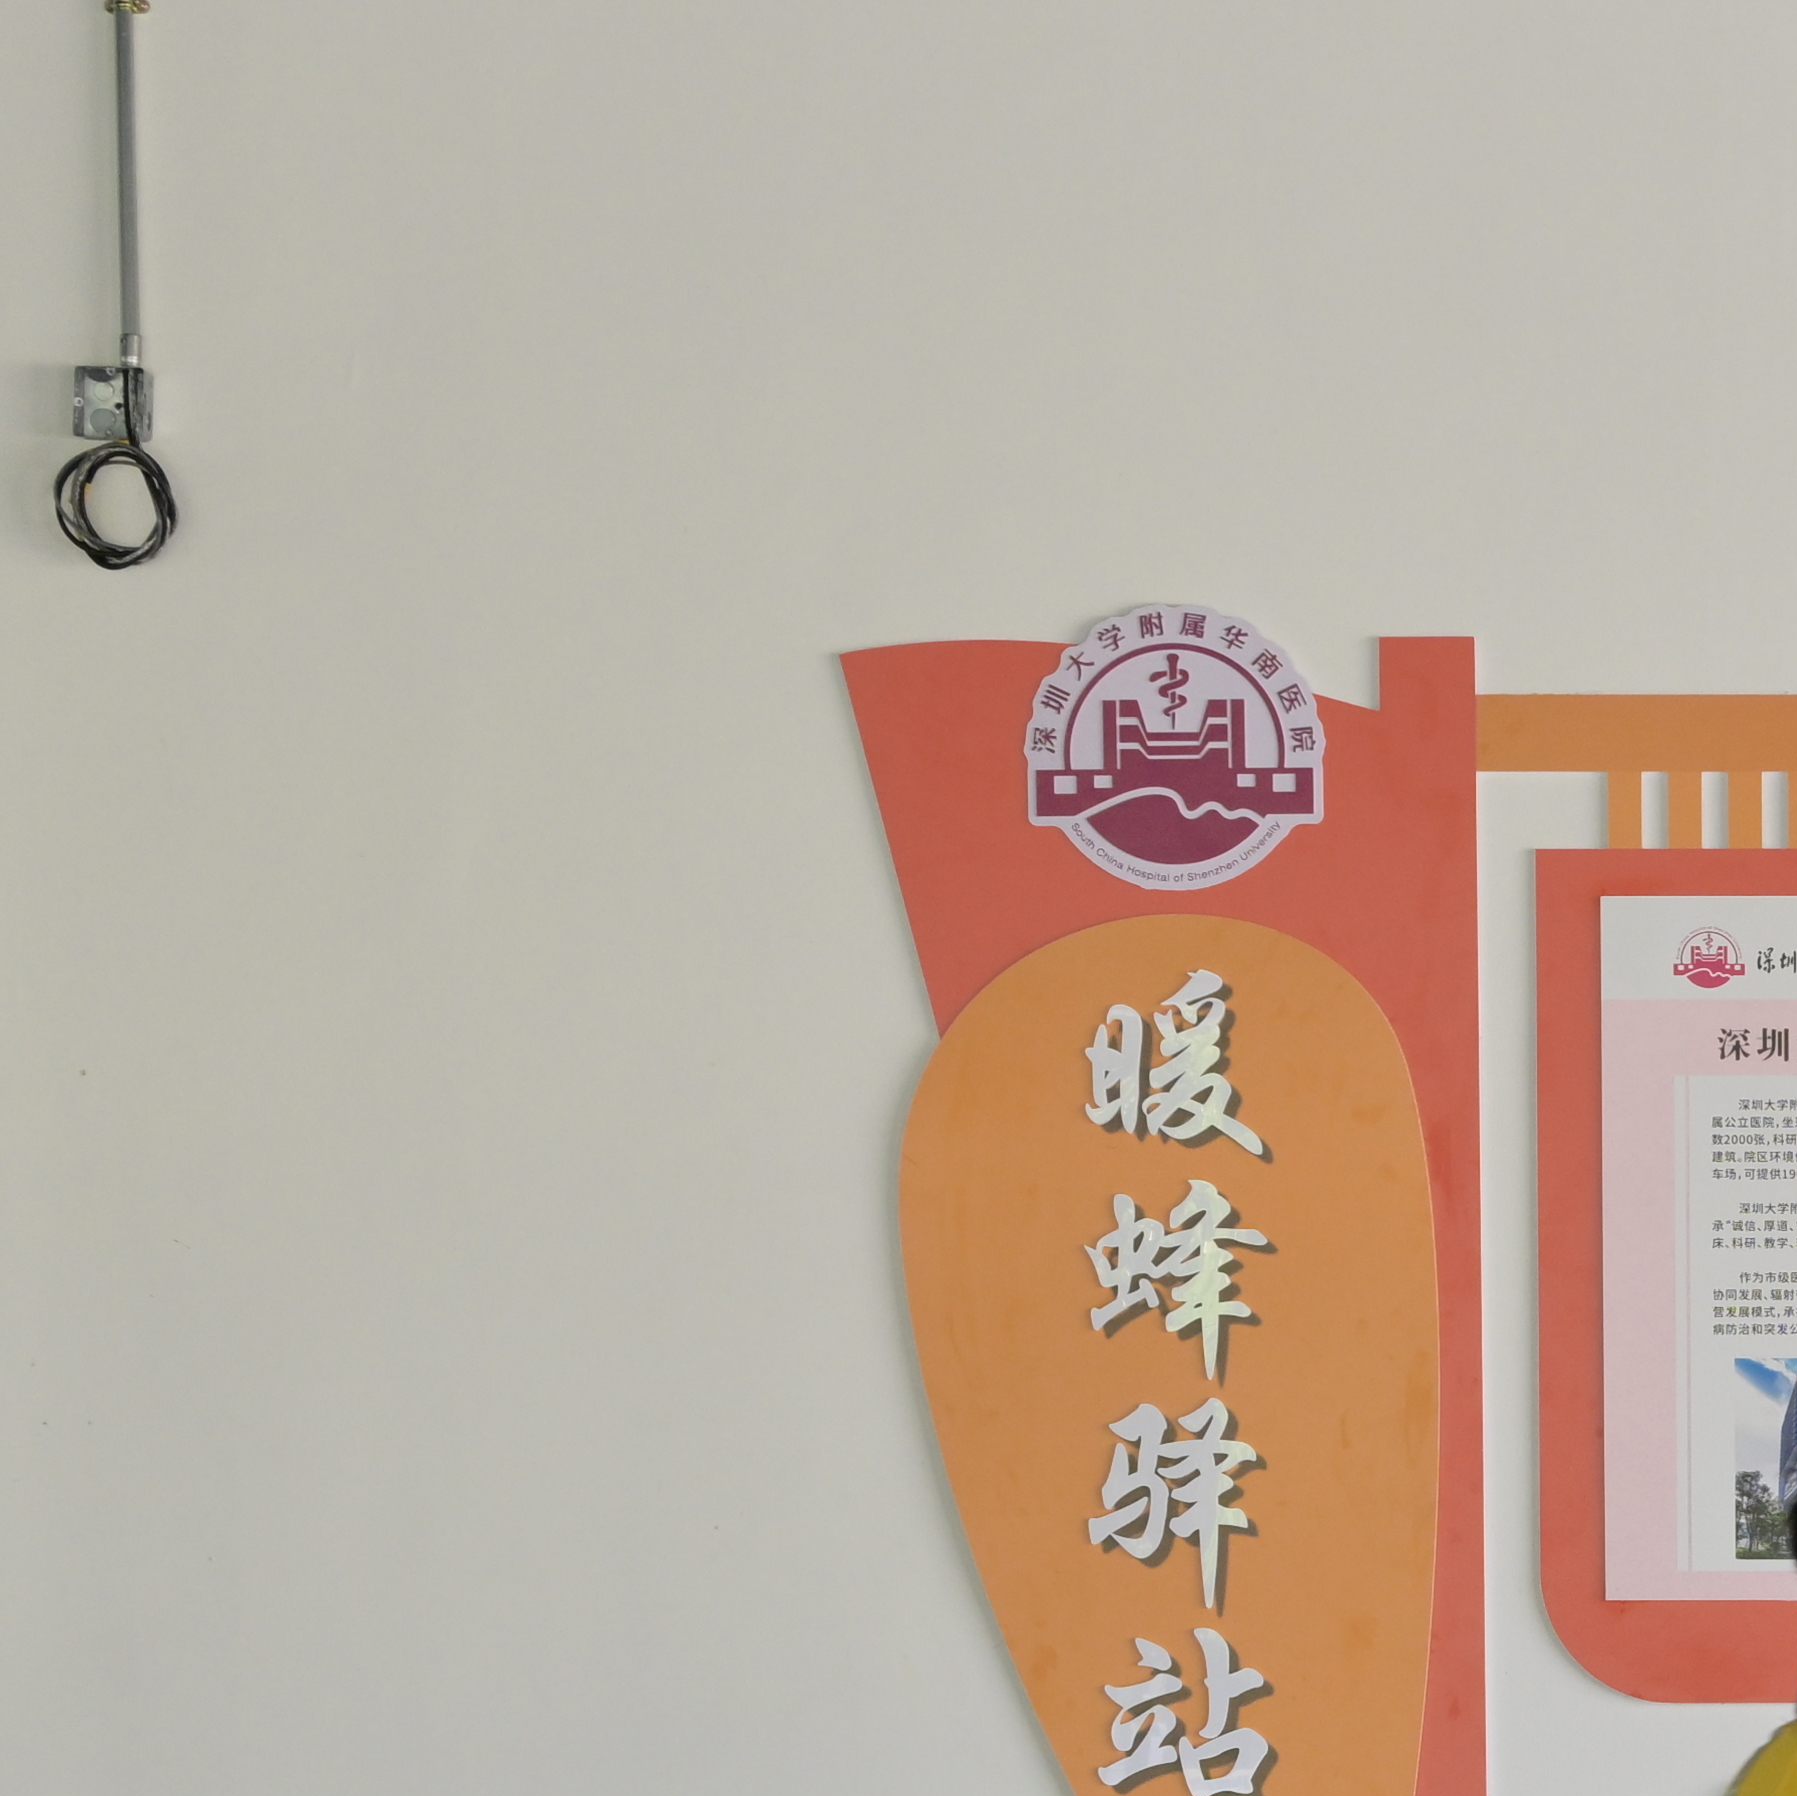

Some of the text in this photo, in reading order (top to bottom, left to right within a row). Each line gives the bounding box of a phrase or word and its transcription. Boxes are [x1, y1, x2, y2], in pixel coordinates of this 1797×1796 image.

[1030, 611, 1317, 754] 深圳大学附属华南医院
[1070, 820, 1281, 883] South China Hospital of Shenzhen University
